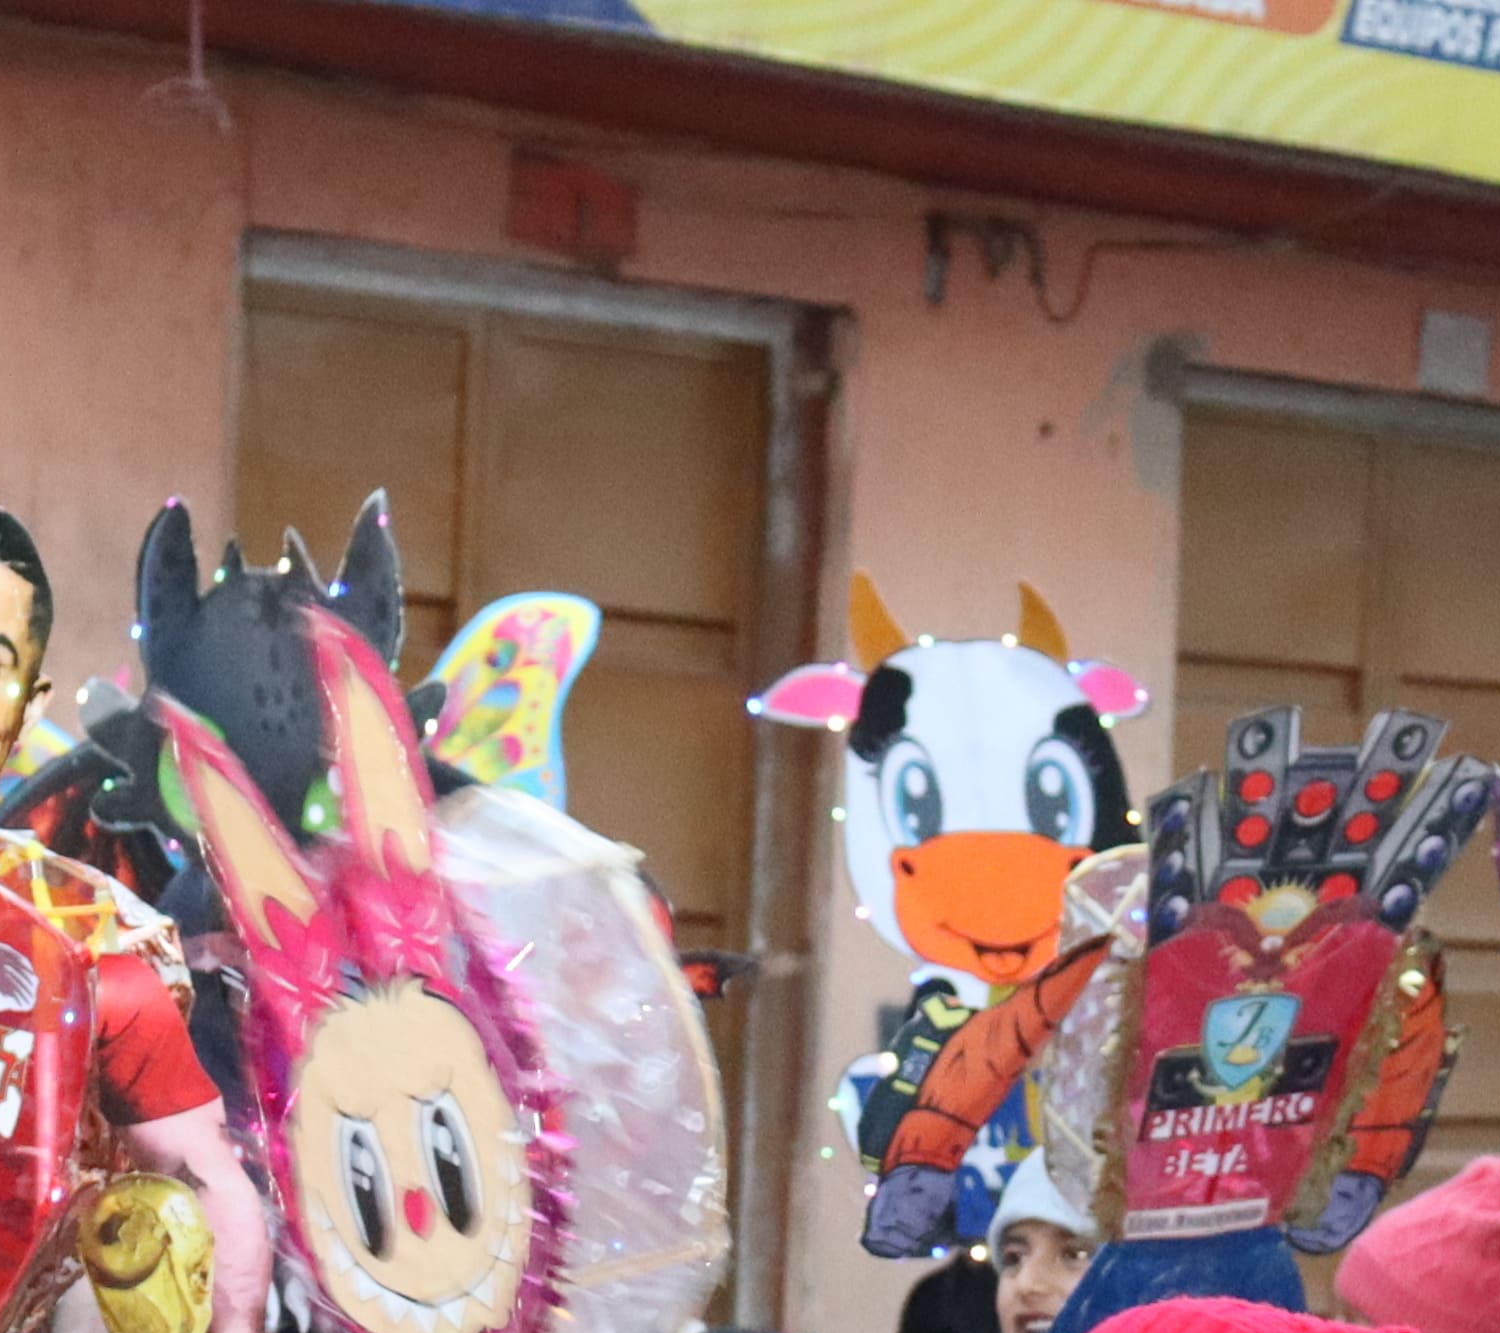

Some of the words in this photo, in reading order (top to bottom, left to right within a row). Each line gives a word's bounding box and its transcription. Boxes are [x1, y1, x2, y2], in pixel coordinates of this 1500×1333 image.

[1350, 3, 1485, 63] EQUIPOS
[1149, 1091, 1315, 1140] PRIMERO
[1164, 1143, 1248, 1178] BETA
